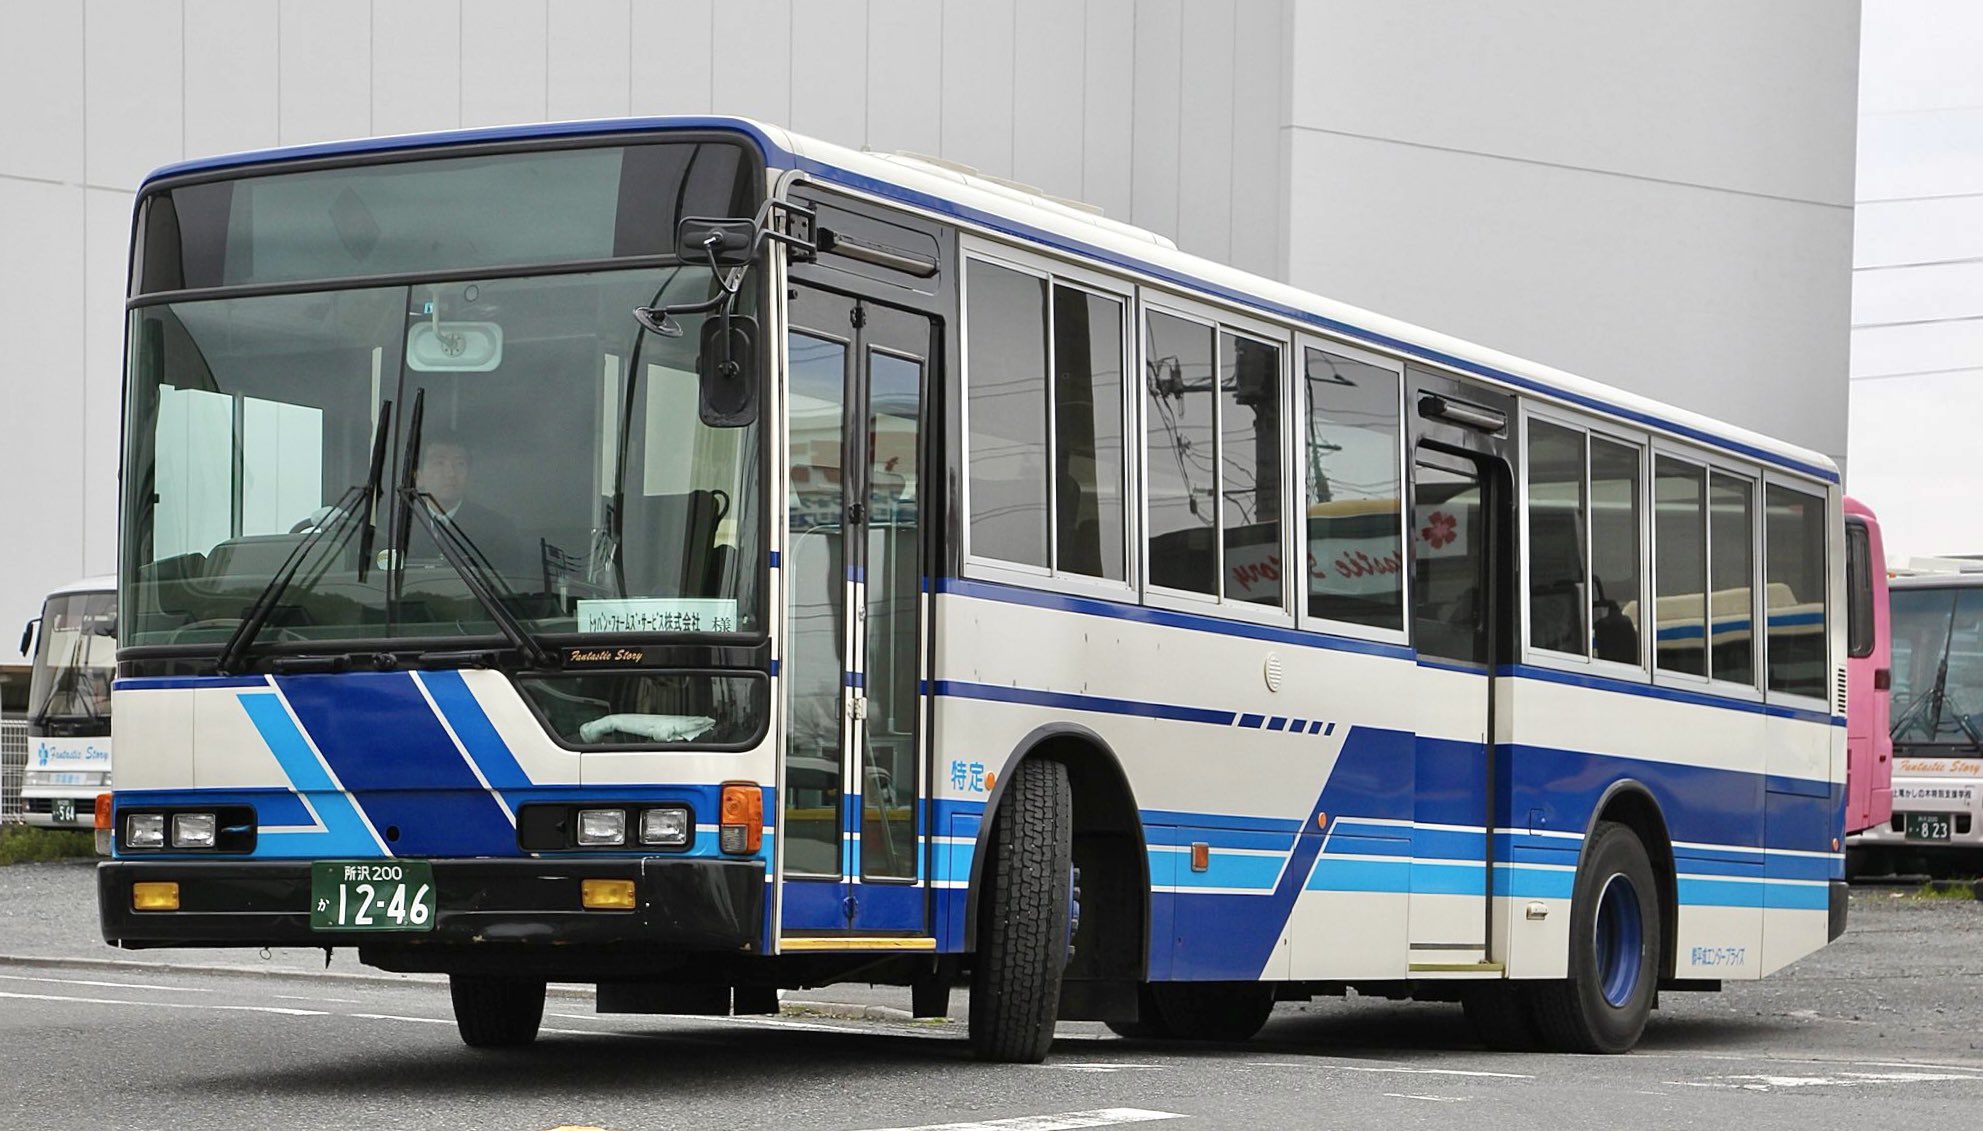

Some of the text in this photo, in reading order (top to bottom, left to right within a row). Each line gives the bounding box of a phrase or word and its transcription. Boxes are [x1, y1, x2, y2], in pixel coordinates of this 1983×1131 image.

[570, 648, 643, 663] Fantastic Story
[50, 746, 109, 762] Fantastic Story
[1901, 760, 1981, 775] Fantastic Story
[951, 760, 984, 792] 特定
[344, 866, 402, 881] 所沢200
[317, 883, 430, 925] か 12-46
